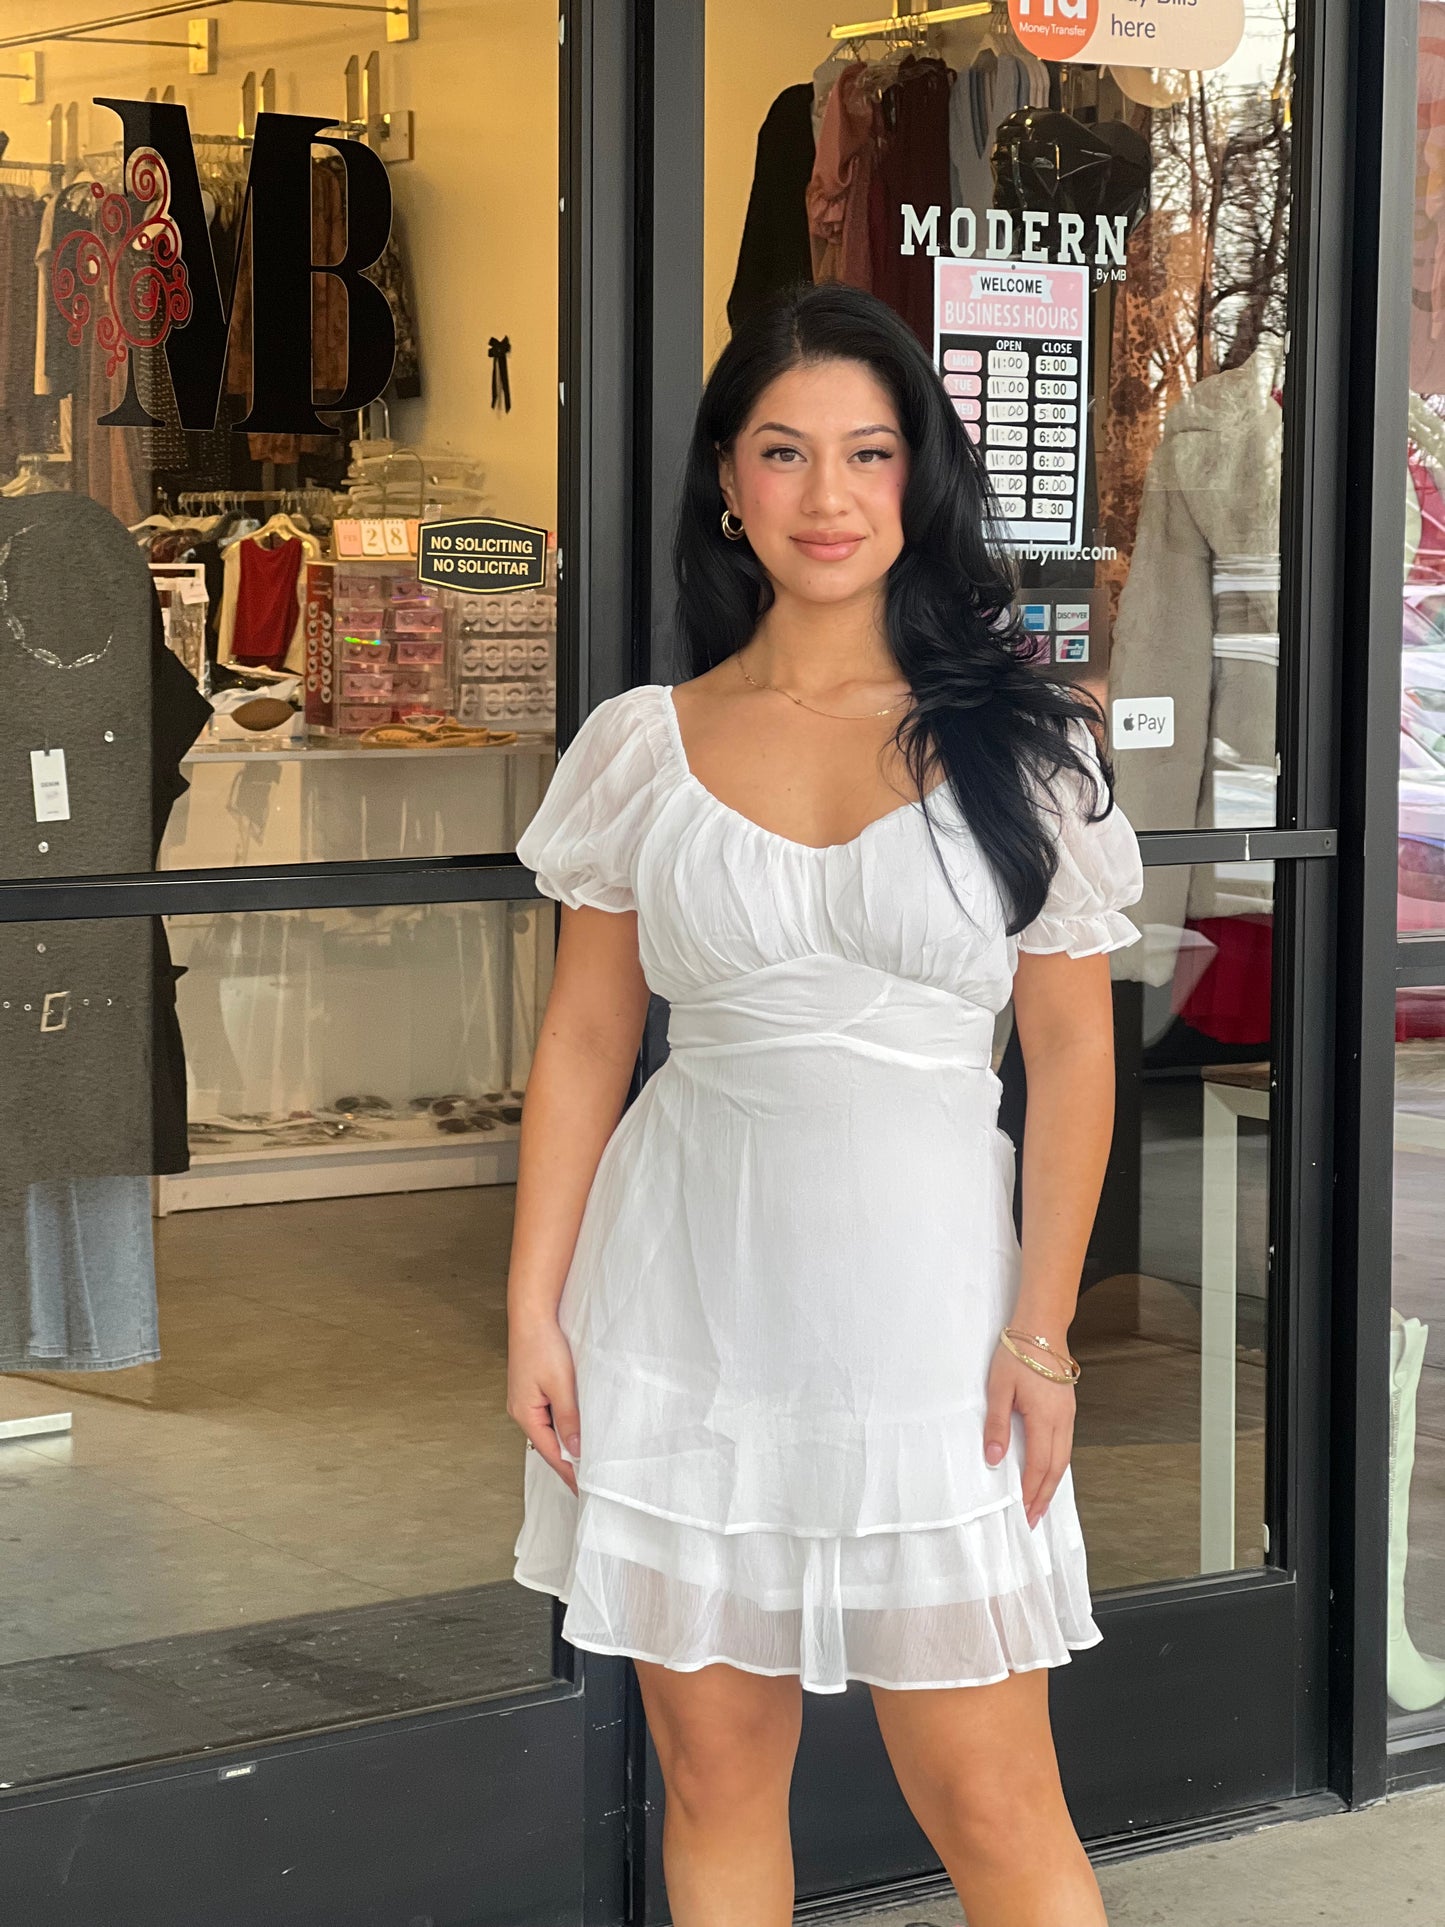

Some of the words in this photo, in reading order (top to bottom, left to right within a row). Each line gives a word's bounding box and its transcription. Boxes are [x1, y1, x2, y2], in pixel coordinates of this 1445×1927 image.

[1019, 22, 1050, 36] Money
[1051, 23, 1087, 36] Transfer
[1111, 13, 1156, 38] here
[900, 203, 1128, 265] MODERN
[92, 97, 397, 436] MB
[1096, 268, 1109, 284] By
[1111, 268, 1127, 281] MB
[980, 276, 1043, 294] WELCOME
[945, 300, 1021, 328] BUSINESS
[1024, 305, 1079, 331] HOURS
[995, 339, 1022, 351] OPEN
[1042, 341, 1073, 354] CLOSE
[951, 354, 975, 367] MON
[992, 356, 1023, 370] 11:00
[1040, 359, 1067, 372] 5:00
[953, 379, 973, 392] TUE
[991, 381, 1024, 394] 11:00
[1040, 382, 1067, 396] 5:00
[991, 405, 1023, 418] 11:00
[991, 428, 1023, 441] 11:00
[1039, 430, 1067, 443] 6:00
[991, 453, 1023, 467] 11:00
[1039, 455, 1065, 468] 6:00
[1038, 478, 1067, 492] 6:00
[1035, 502, 1064, 515] 3:30
[430, 535, 452, 551] NO
[455, 537, 533, 554] SOLICITING
[433, 558, 454, 572] NO
[457, 560, 529, 576] SOLICITAR
[1138, 713, 1166, 734] Pay
